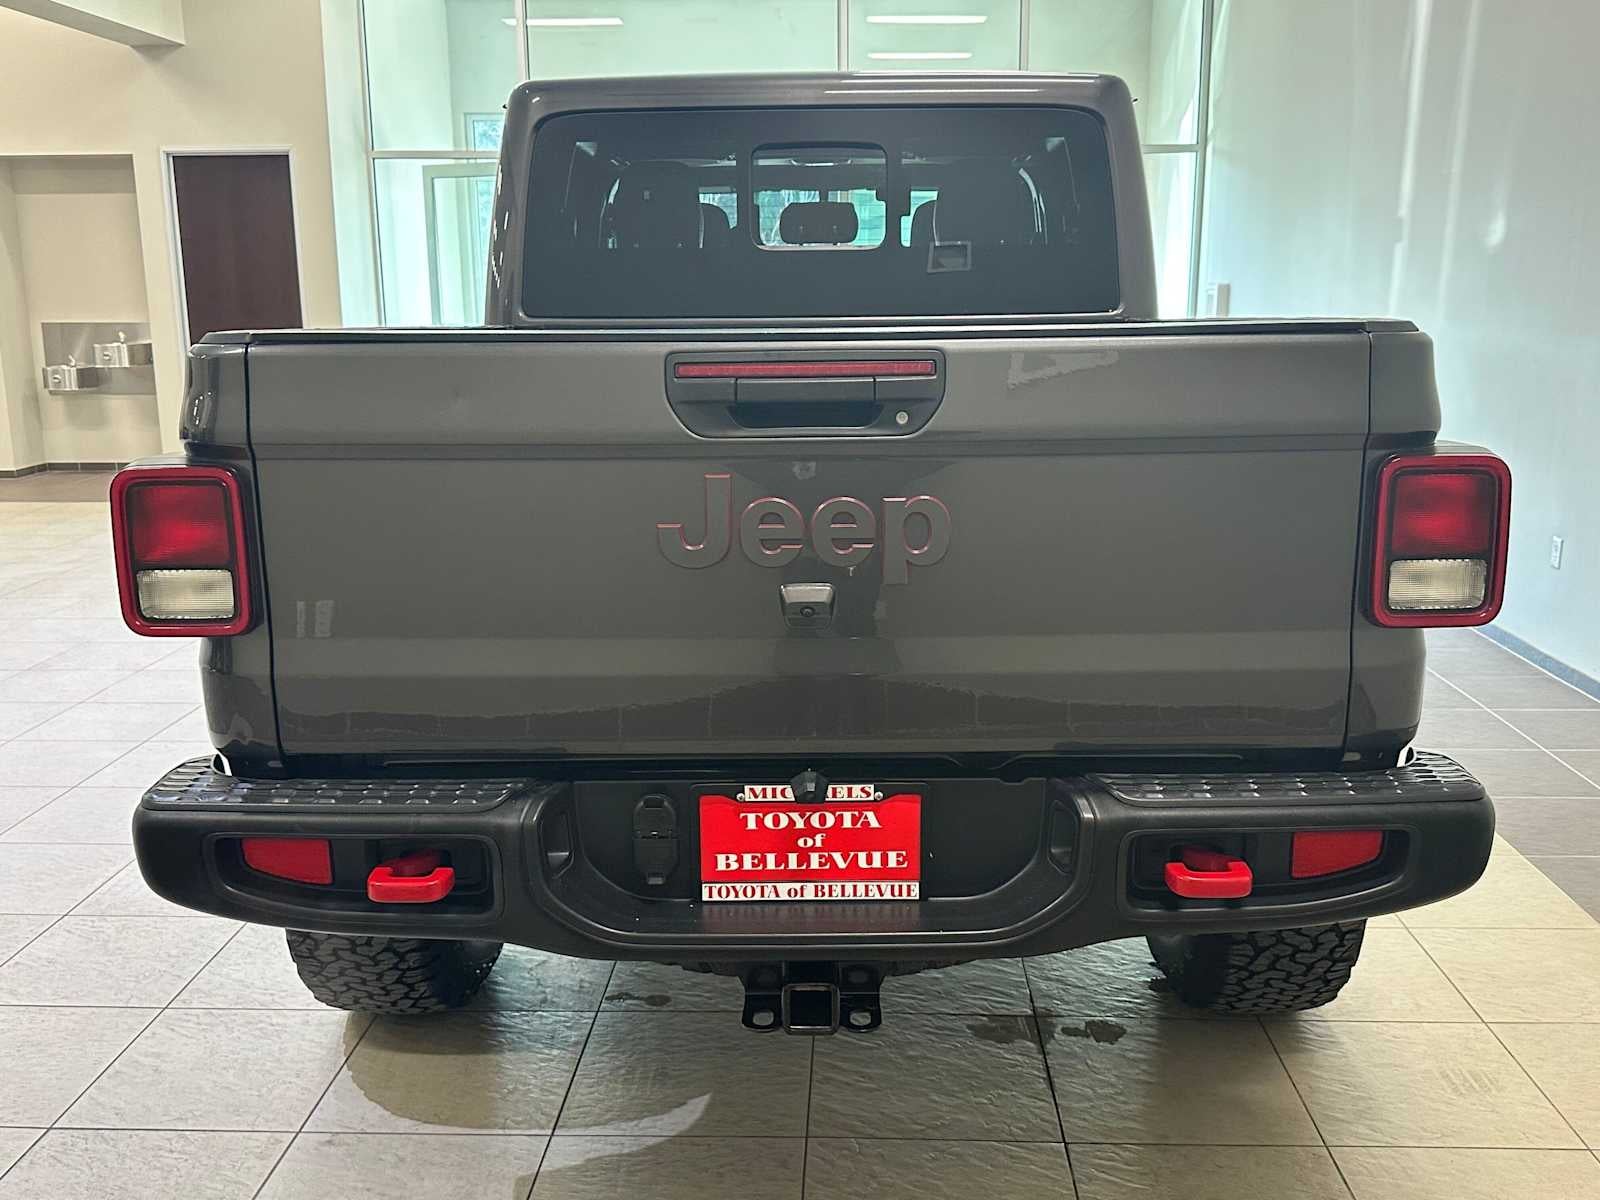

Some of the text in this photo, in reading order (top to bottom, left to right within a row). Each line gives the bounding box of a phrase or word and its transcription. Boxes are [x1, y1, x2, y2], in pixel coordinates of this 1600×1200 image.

[656, 472, 952, 585] Jeep
[748, 786, 872, 799] MICELS
[740, 811, 882, 830] TOYOTA
[797, 833, 827, 848] of
[715, 850, 908, 871] BELLEVUE
[704, 884, 918, 899] TOYOTA of BELLEVUE
